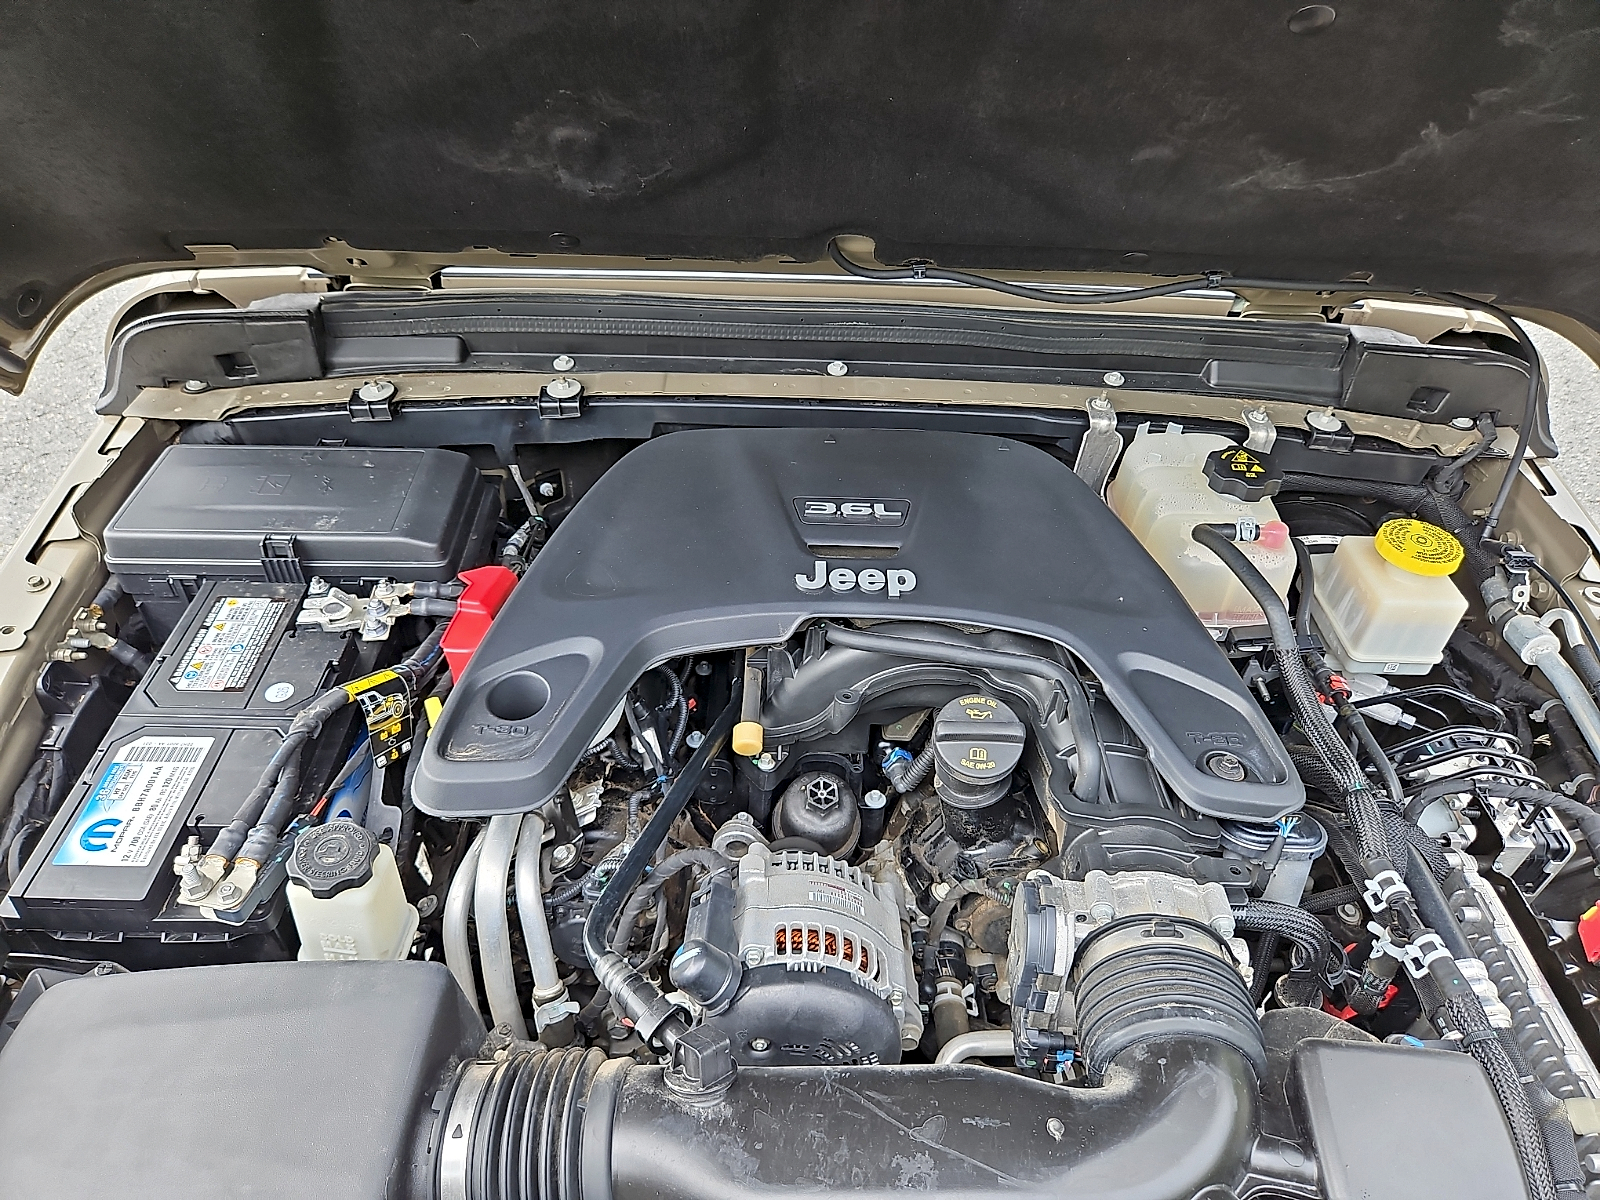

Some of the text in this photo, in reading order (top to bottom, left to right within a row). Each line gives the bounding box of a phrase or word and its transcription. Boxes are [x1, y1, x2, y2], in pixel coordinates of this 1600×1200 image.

[804, 501, 902, 519] 3.6L
[793, 560, 917, 599] Jeep
[959, 697, 998, 708] ENGINE OIL
[960, 758, 996, 770] SAE 0W-20
[111, 818, 134, 853] MOPAR
[327, 822, 364, 840] APPROVED
[297, 846, 310, 874] POWER
[310, 866, 349, 878] STEERING
[320, 932, 354, 943] COLD
[320, 940, 356, 950] MAX
